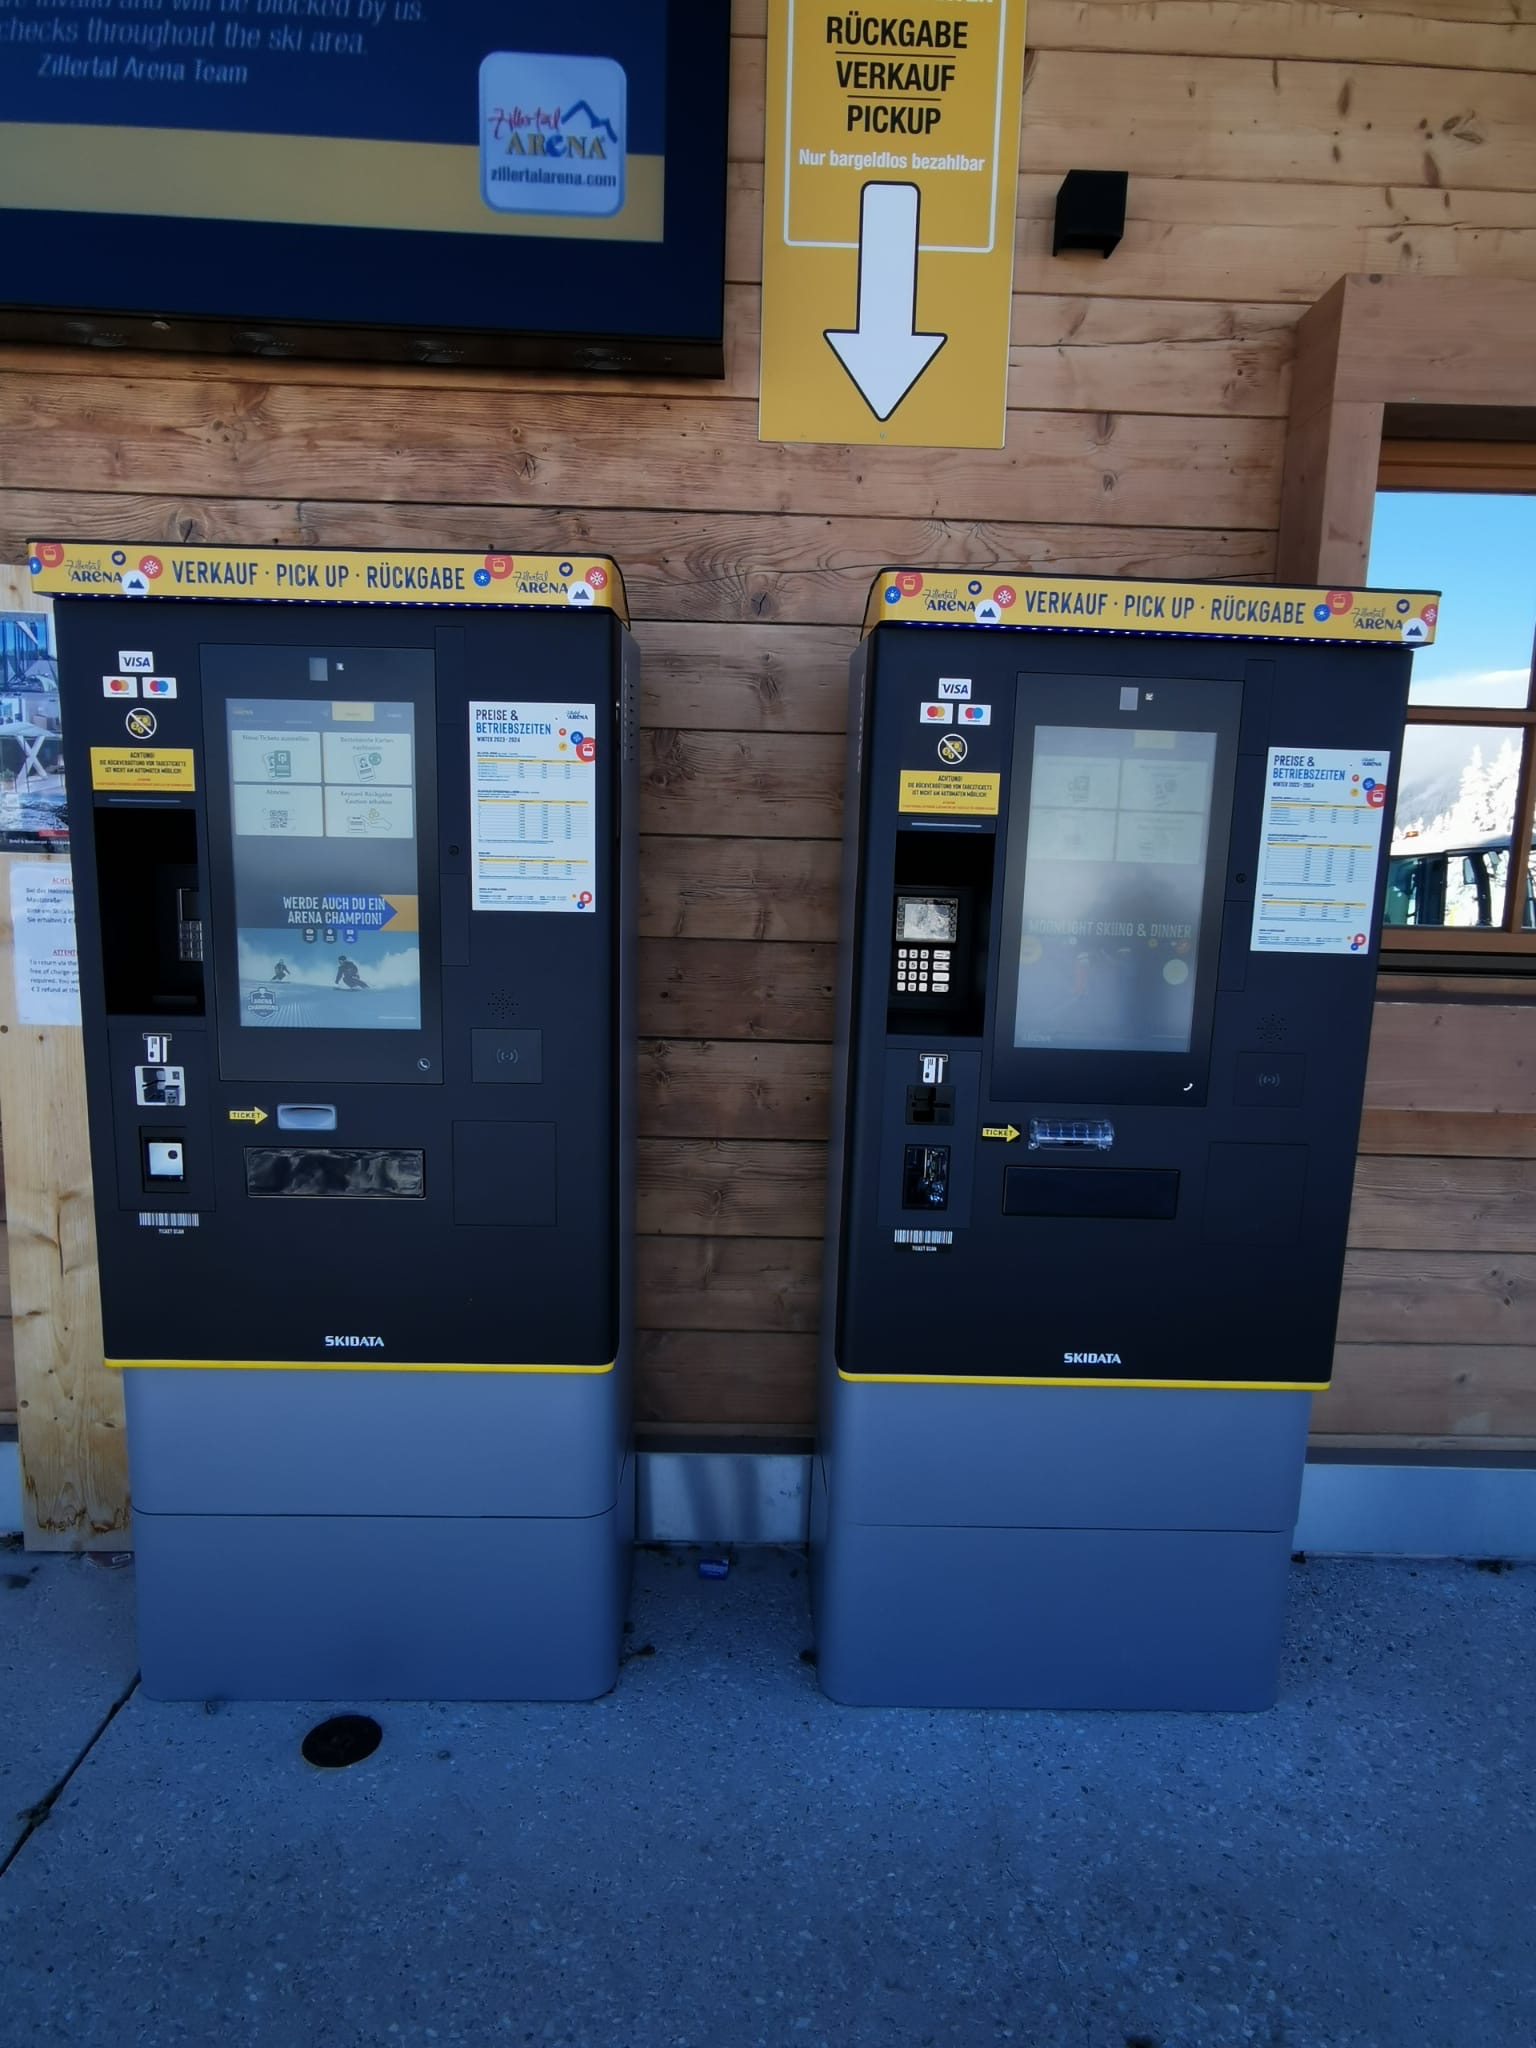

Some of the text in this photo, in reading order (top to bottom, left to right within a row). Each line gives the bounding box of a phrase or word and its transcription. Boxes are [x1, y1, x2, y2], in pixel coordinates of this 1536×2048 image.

[88, 18, 217, 49] throughout
[225, 22, 260, 48] the
[269, 24, 303, 51] ski
[826, 11, 968, 49] RÜCKGABE
[38, 53, 248, 83] Zillertal Arena Team
[836, 60, 956, 92] VERKAUF
[847, 105, 941, 135] PICKUP
[800, 149, 985, 172] Nur bargeldlos bezahlbar
[491, 166, 617, 187] zillertalarena.com
[172, 561, 465, 590] VERKAUF PICK UP RÜCKGABE
[1025, 590, 1305, 625] VERKAUF PICK UP RÜCKGABE
[123, 657, 150, 667] VISA
[942, 684, 968, 694] VISA
[476, 709, 518, 720] PREISE &
[476, 722, 551, 735] BETRIEBSZEITEN
[1274, 755, 1315, 767] PREISE &
[1273, 768, 1345, 781] BETRIEBSZEITEN
[283, 896, 386, 911] WERDE AUCH DU EIN
[288, 911, 382, 925] ARENA CHAMPION!
[1030, 920, 1192, 938] MOONLIGHT SKIING & DINNER
[985, 1129, 1014, 1137] TICKET
[325, 1335, 384, 1347] SKIDATA
[1063, 1352, 1122, 1364] SKIDATA
